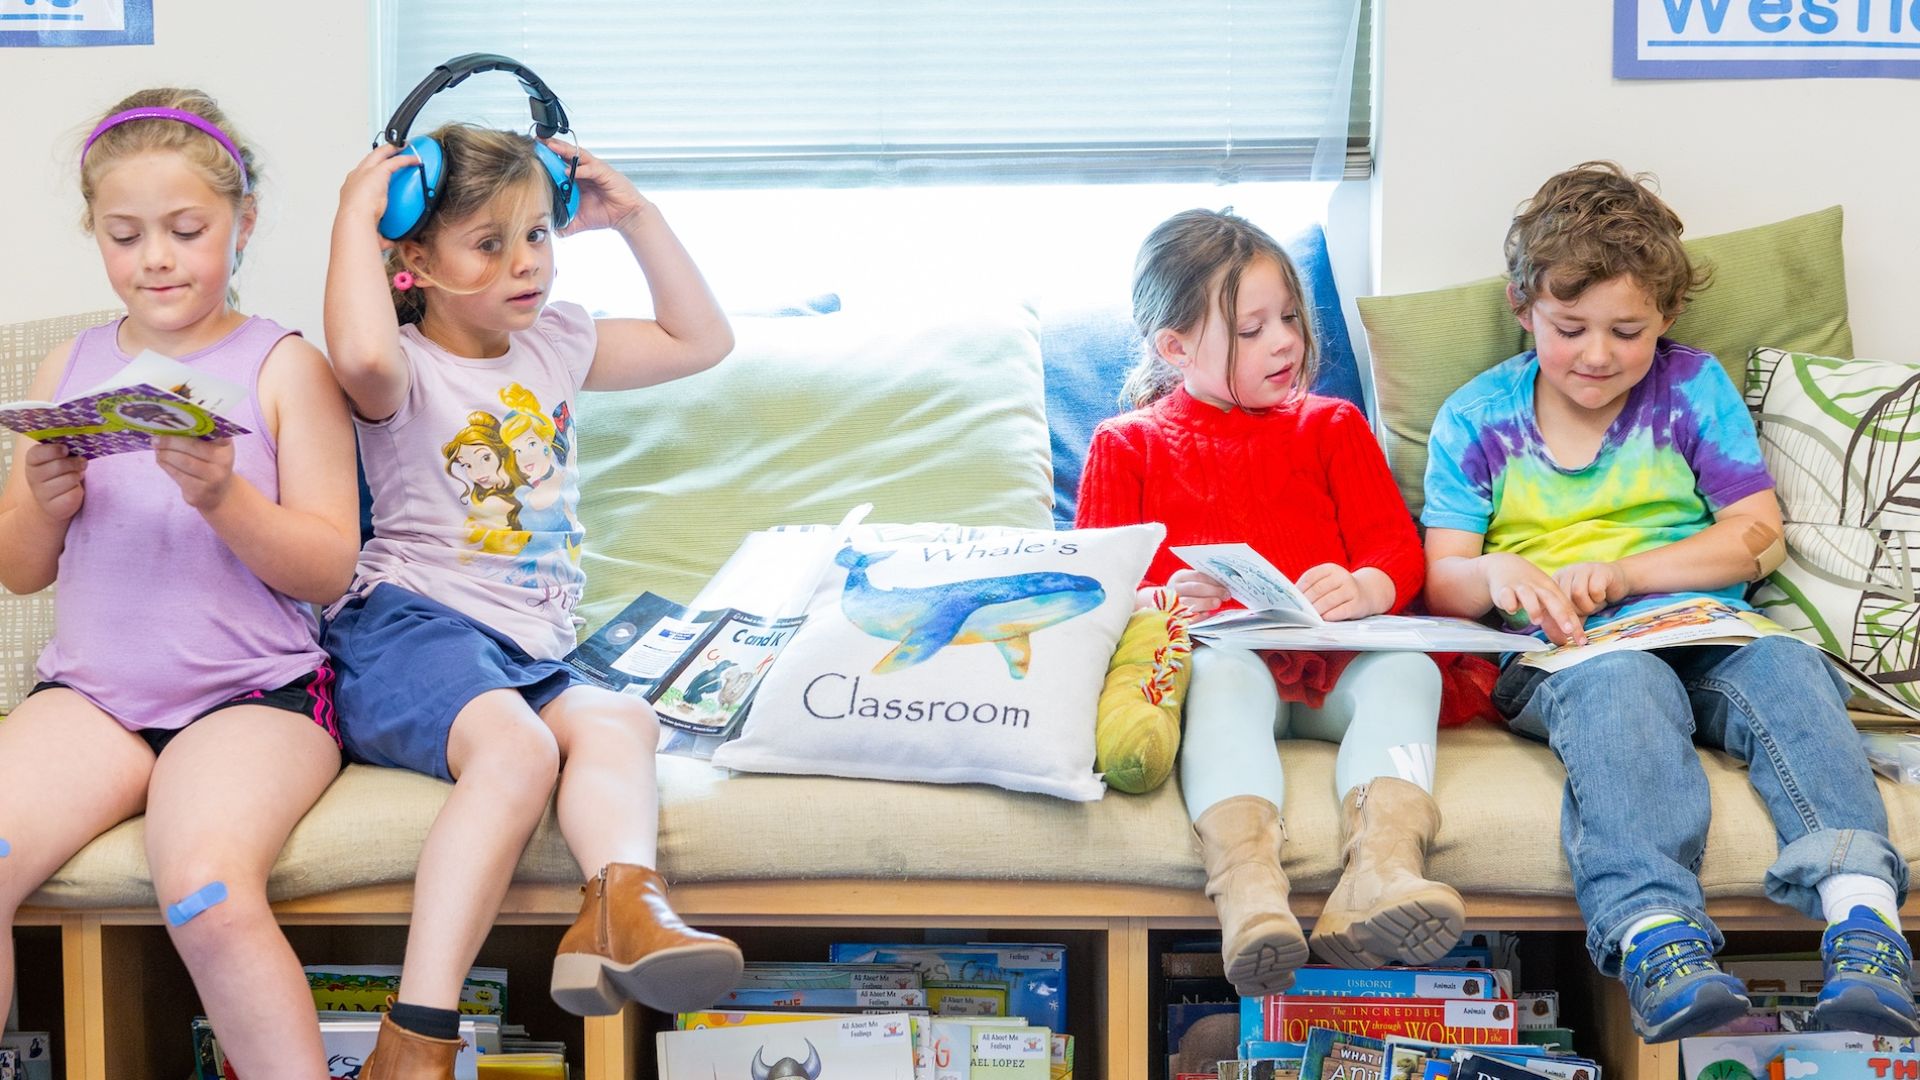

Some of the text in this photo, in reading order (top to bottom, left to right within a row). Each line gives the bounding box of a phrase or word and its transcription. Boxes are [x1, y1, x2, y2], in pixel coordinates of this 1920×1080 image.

[923, 538, 1079, 562] Whale's
[732, 628, 787, 647] C and K
[803, 672, 1030, 729] Classroom
[1347, 979, 1393, 988] USBORNE
[1331, 1006, 1346, 1016] The
[851, 1021, 867, 1029] About
[1404, 1021, 1489, 1045] WORLD
[990, 1042, 1012, 1051] Feelings
[1844, 1042, 1864, 1050] Family
[1340, 1049, 1373, 1063] WHAT
